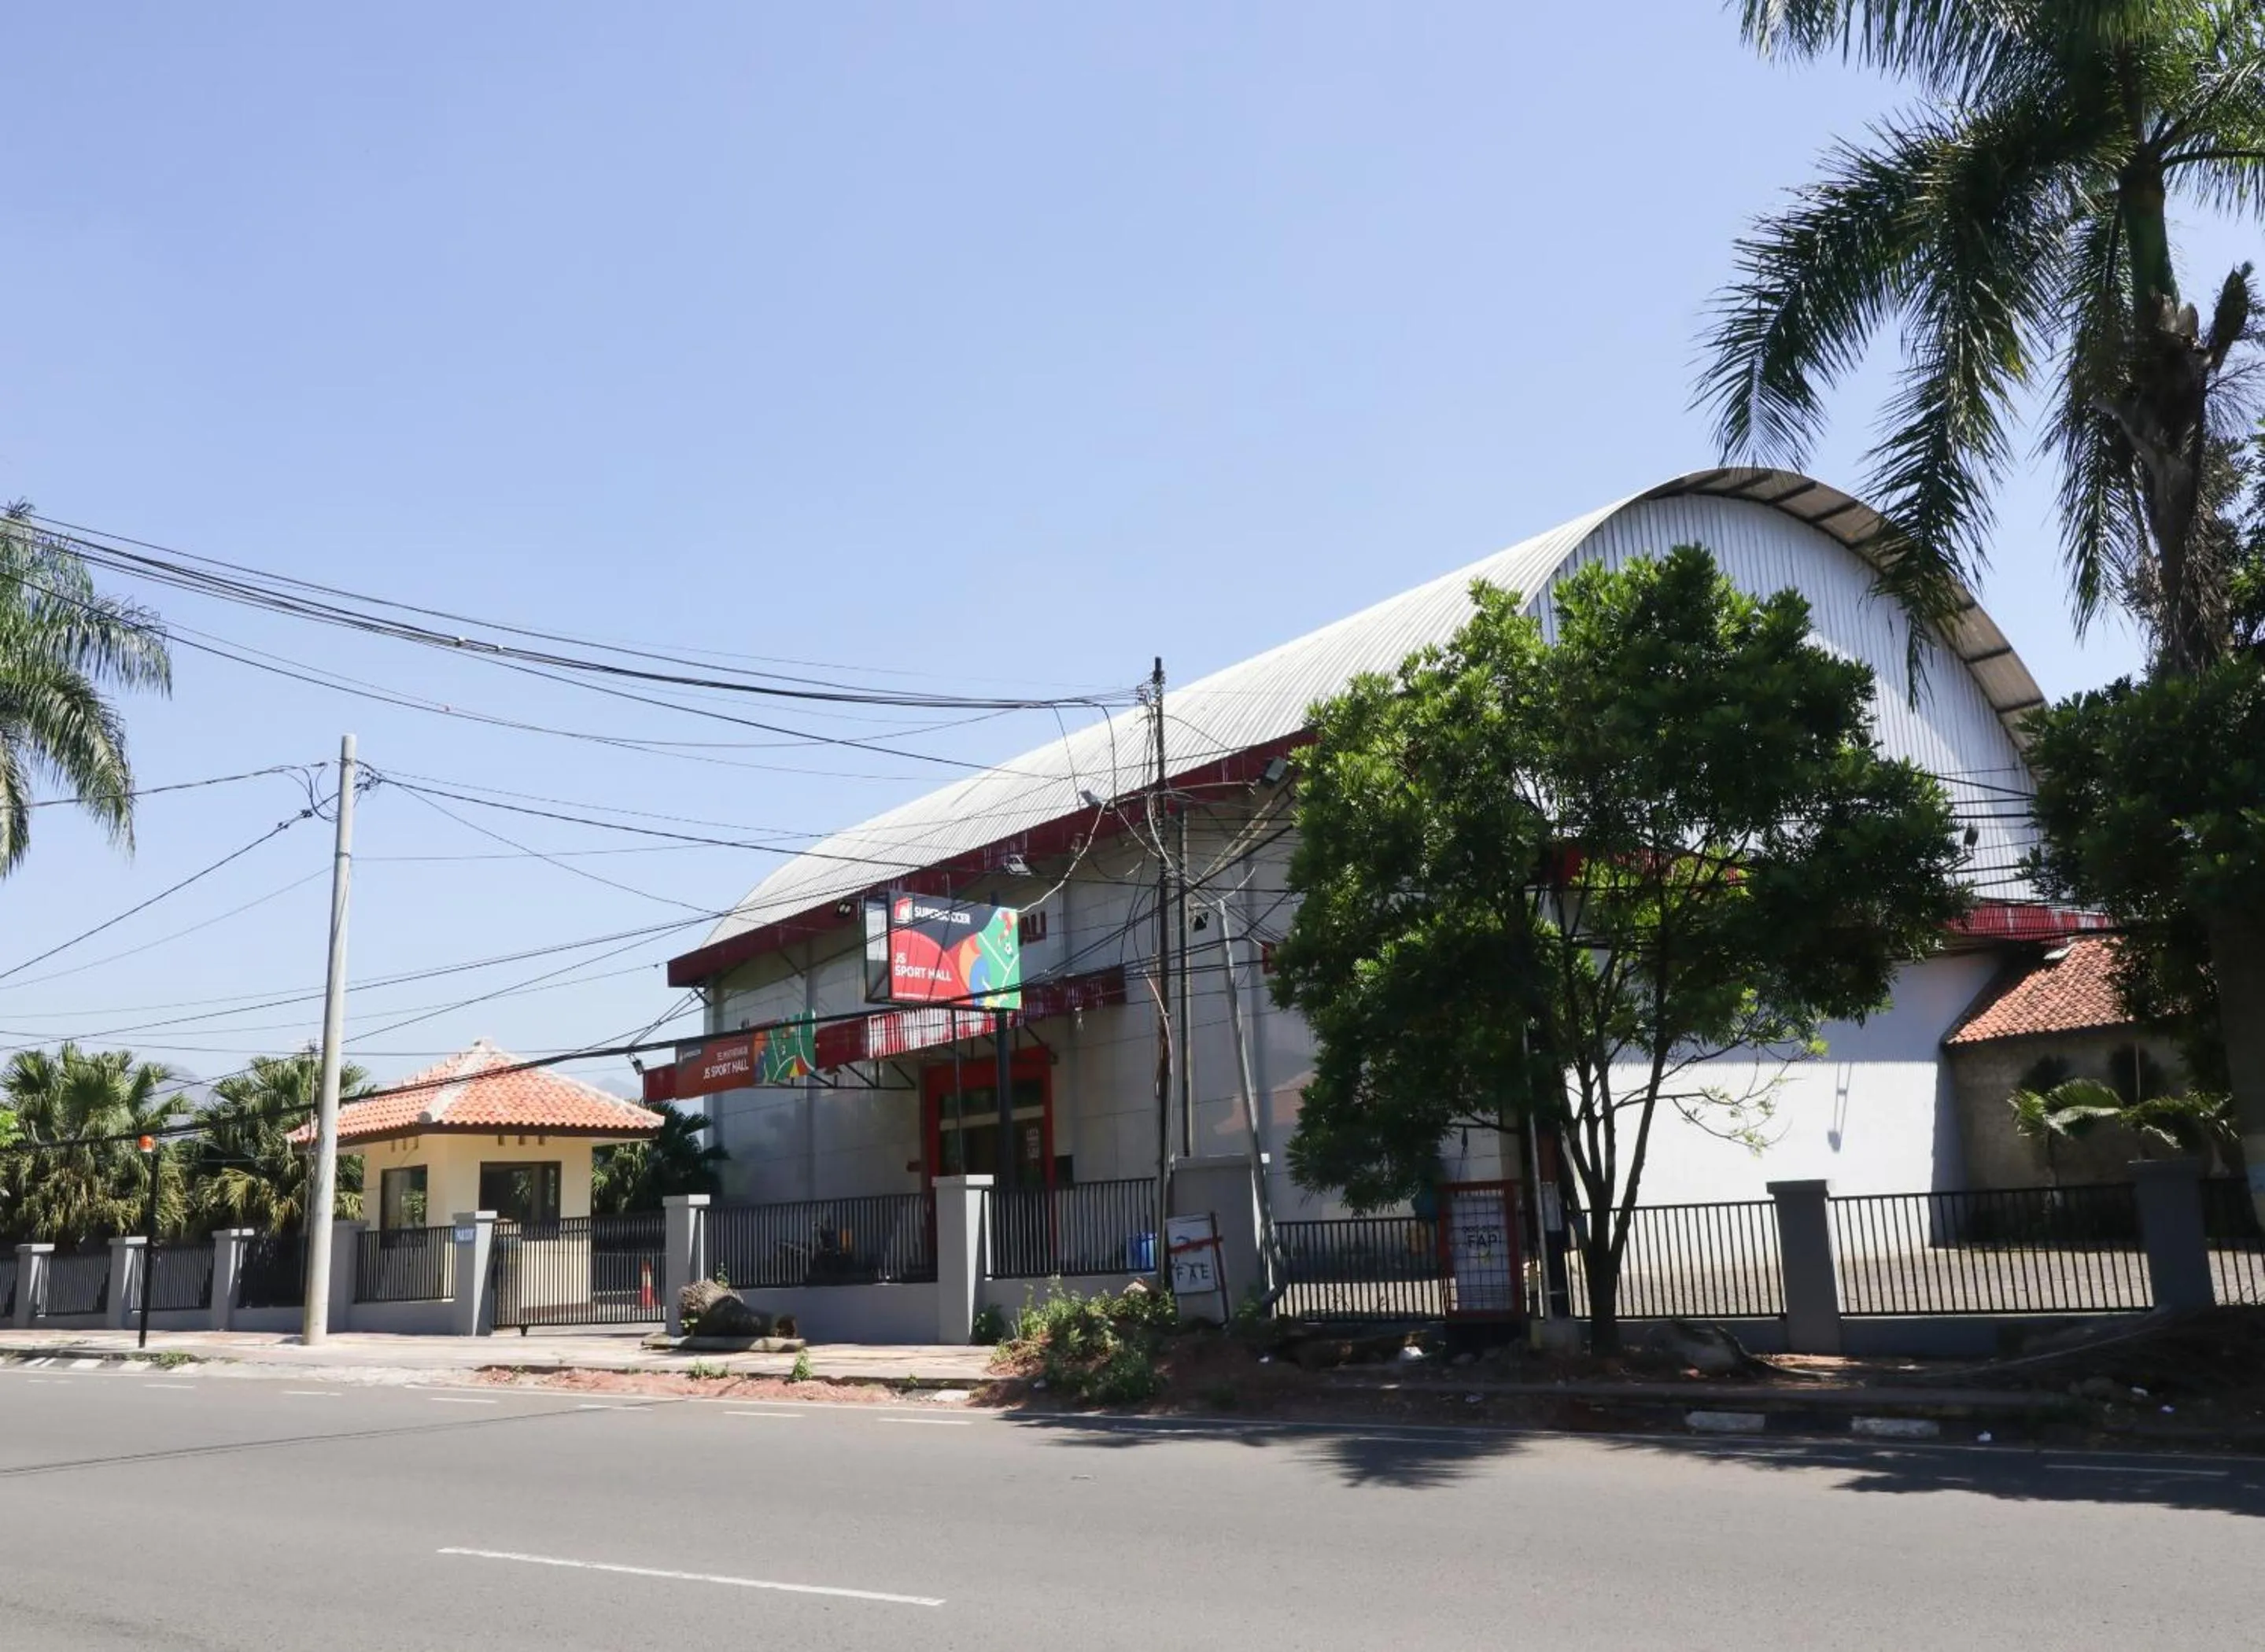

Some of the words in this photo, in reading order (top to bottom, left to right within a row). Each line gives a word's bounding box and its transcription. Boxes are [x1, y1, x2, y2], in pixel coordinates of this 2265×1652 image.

[895, 965, 927, 979] SPORT
[928, 968, 952, 982] HALL
[710, 1061, 732, 1078] SPORT
[732, 1056, 749, 1074] HALL
